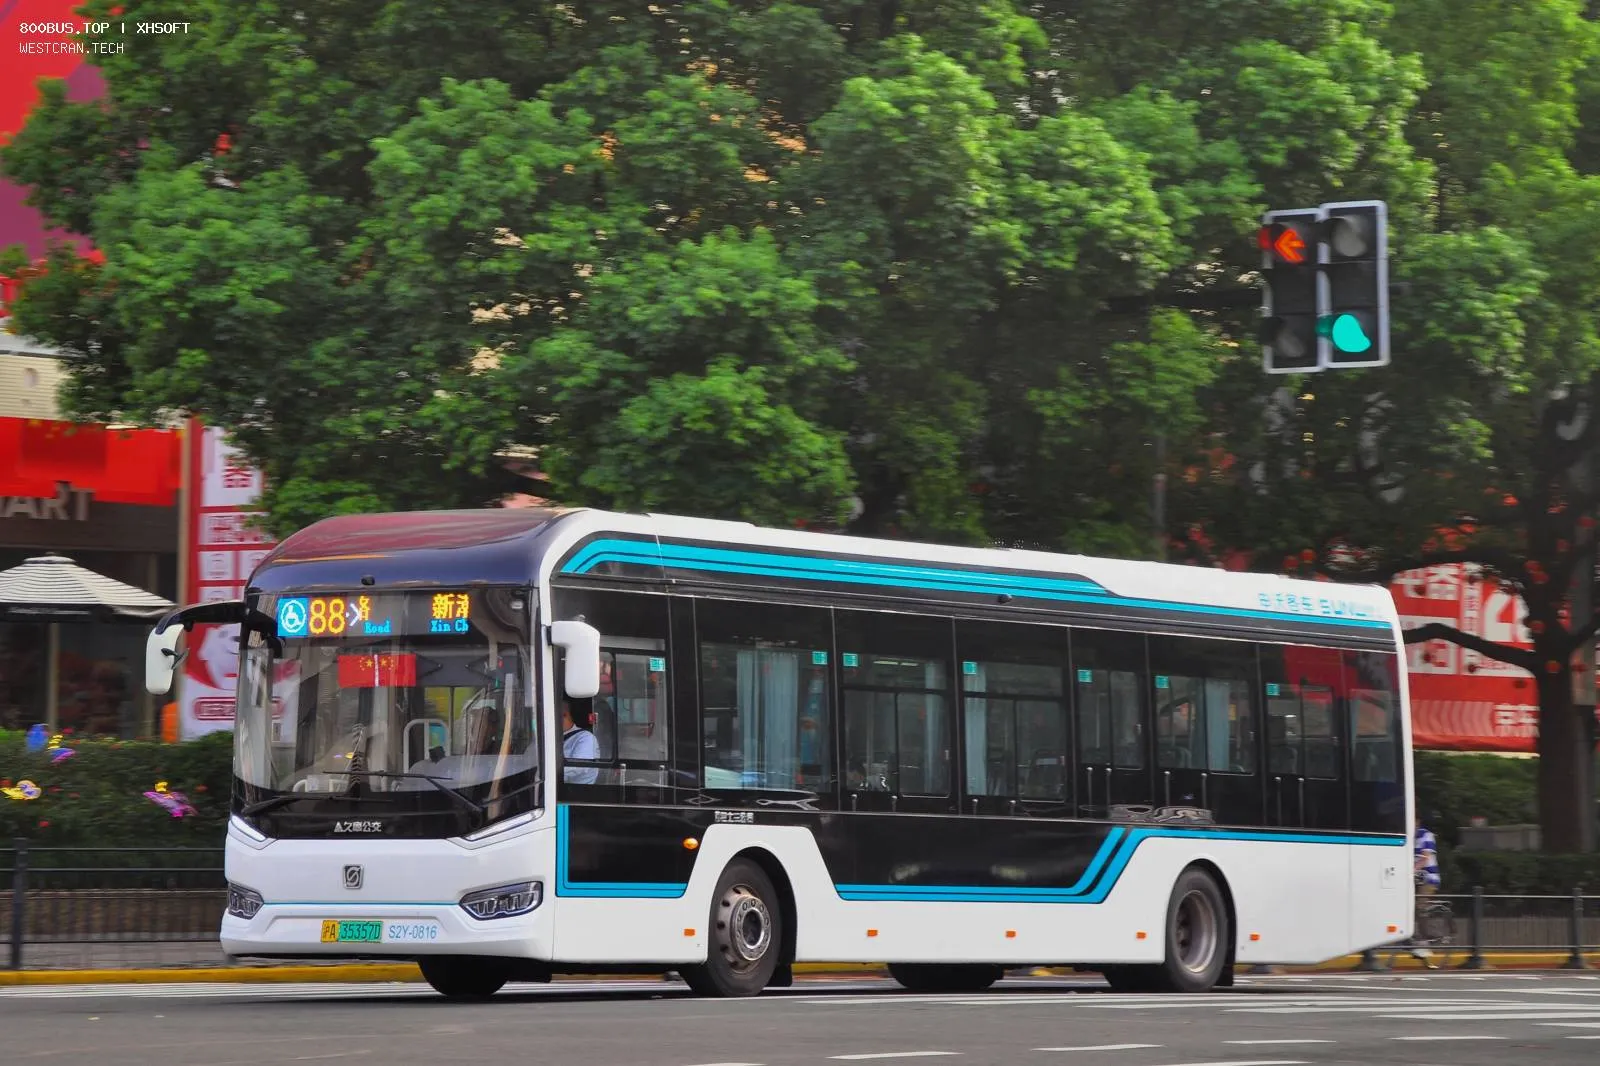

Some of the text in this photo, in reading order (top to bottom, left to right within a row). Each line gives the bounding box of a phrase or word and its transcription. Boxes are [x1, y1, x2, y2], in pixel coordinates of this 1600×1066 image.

[0, 482, 97, 521] ART
[310, 598, 345, 633] 88
[365, 618, 391, 633] Road
[431, 620, 451, 632] Xin
[387, 925, 438, 940] S2Y-0816
